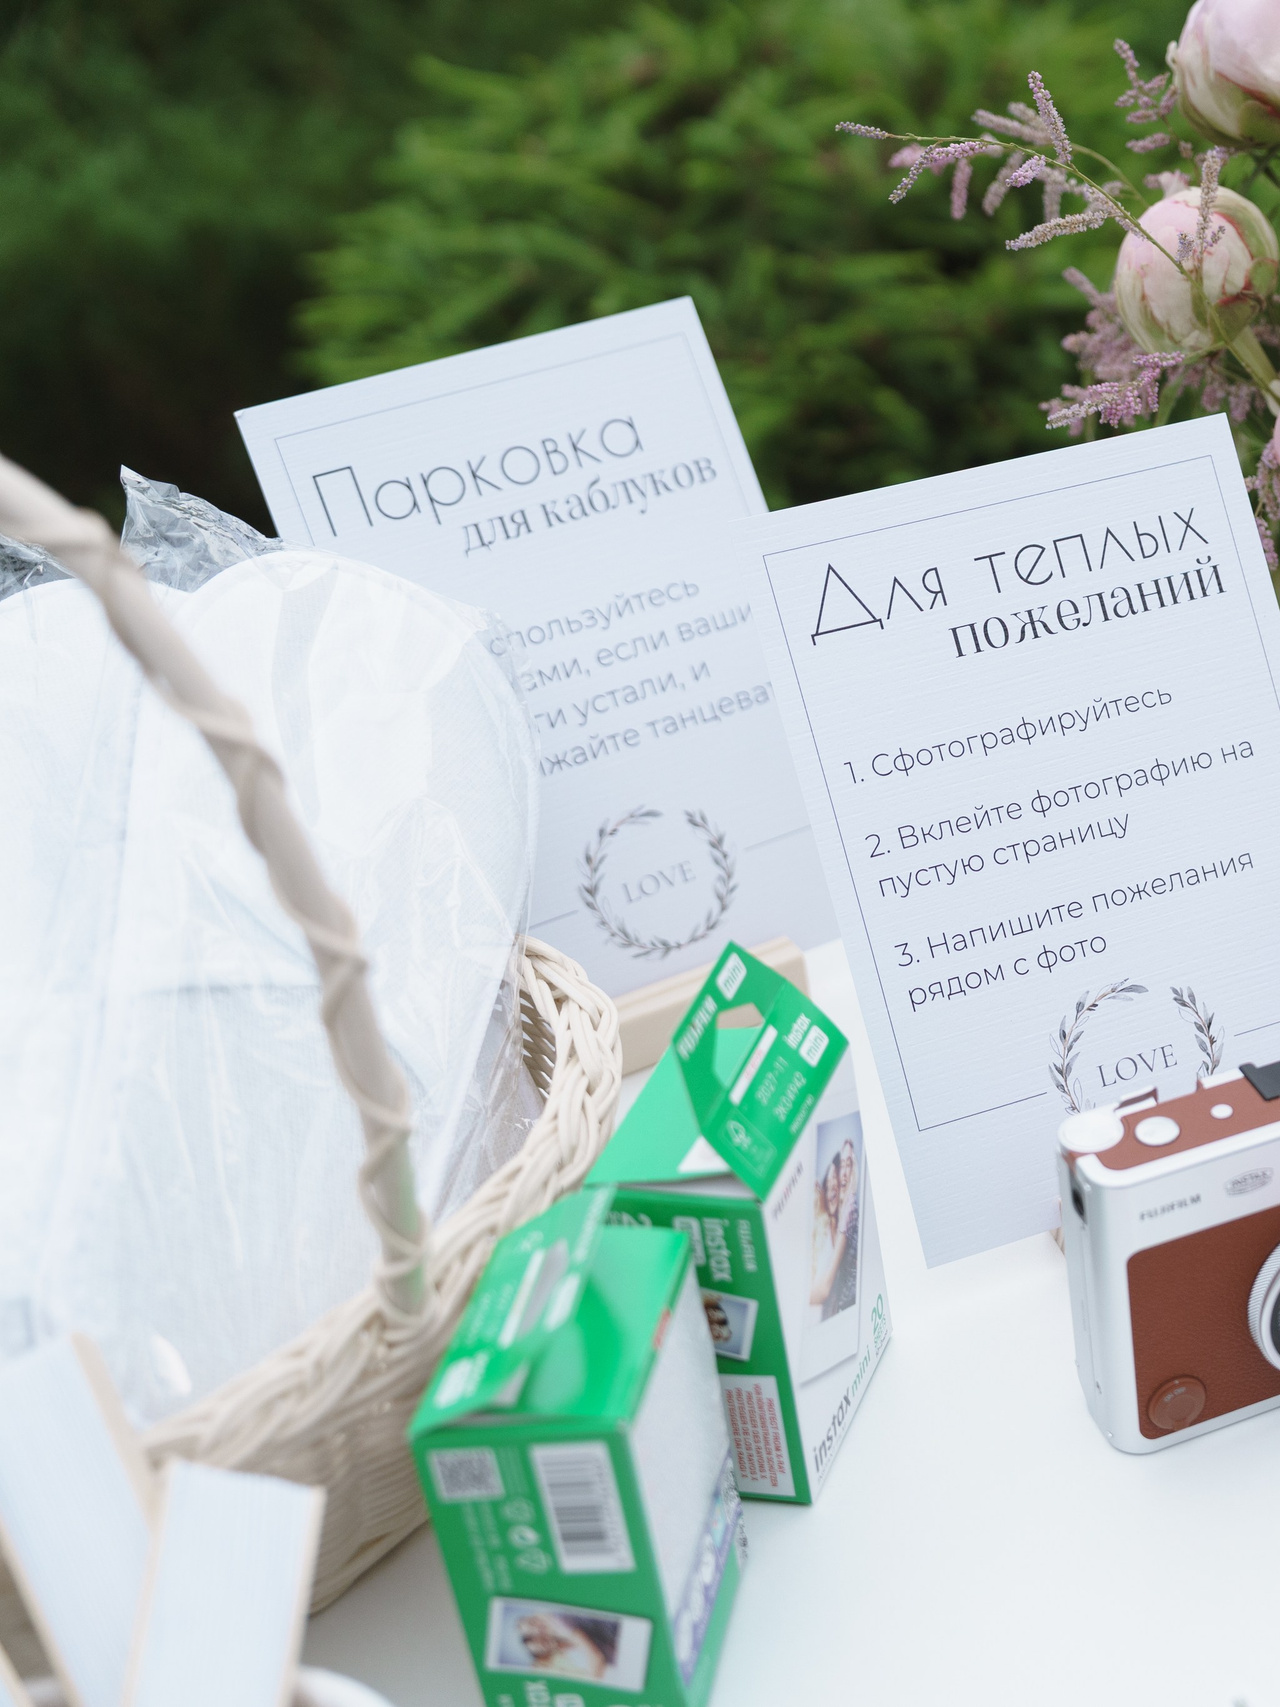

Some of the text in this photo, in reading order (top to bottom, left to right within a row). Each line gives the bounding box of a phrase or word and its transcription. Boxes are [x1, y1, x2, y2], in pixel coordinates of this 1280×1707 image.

[312, 416, 644, 537] Парковка
[461, 456, 718, 558] для каблуков
[489, 580, 700, 656] спользуйтесь
[811, 506, 1210, 646] Для теплых
[948, 555, 1227, 659] пожеланий
[519, 603, 752, 692] ами, если ваши
[573, 672, 686, 727] устали,
[691, 661, 711, 683] и
[844, 685, 1173, 784] 1. Сфотографируйтесь
[865, 739, 1255, 858] 2. Вклейте фотографию на
[620, 860, 697, 905] LOVE
[878, 814, 1132, 898] пустую страницу
[895, 851, 1256, 968] 3. Напишите пожелания
[908, 934, 1108, 1012] рядом с фото
[783, 1013, 812, 1050] instax
[1096, 1045, 1179, 1089] LOVE
[811, 1386, 852, 1473] instax
[850, 1344, 871, 1399] mini
